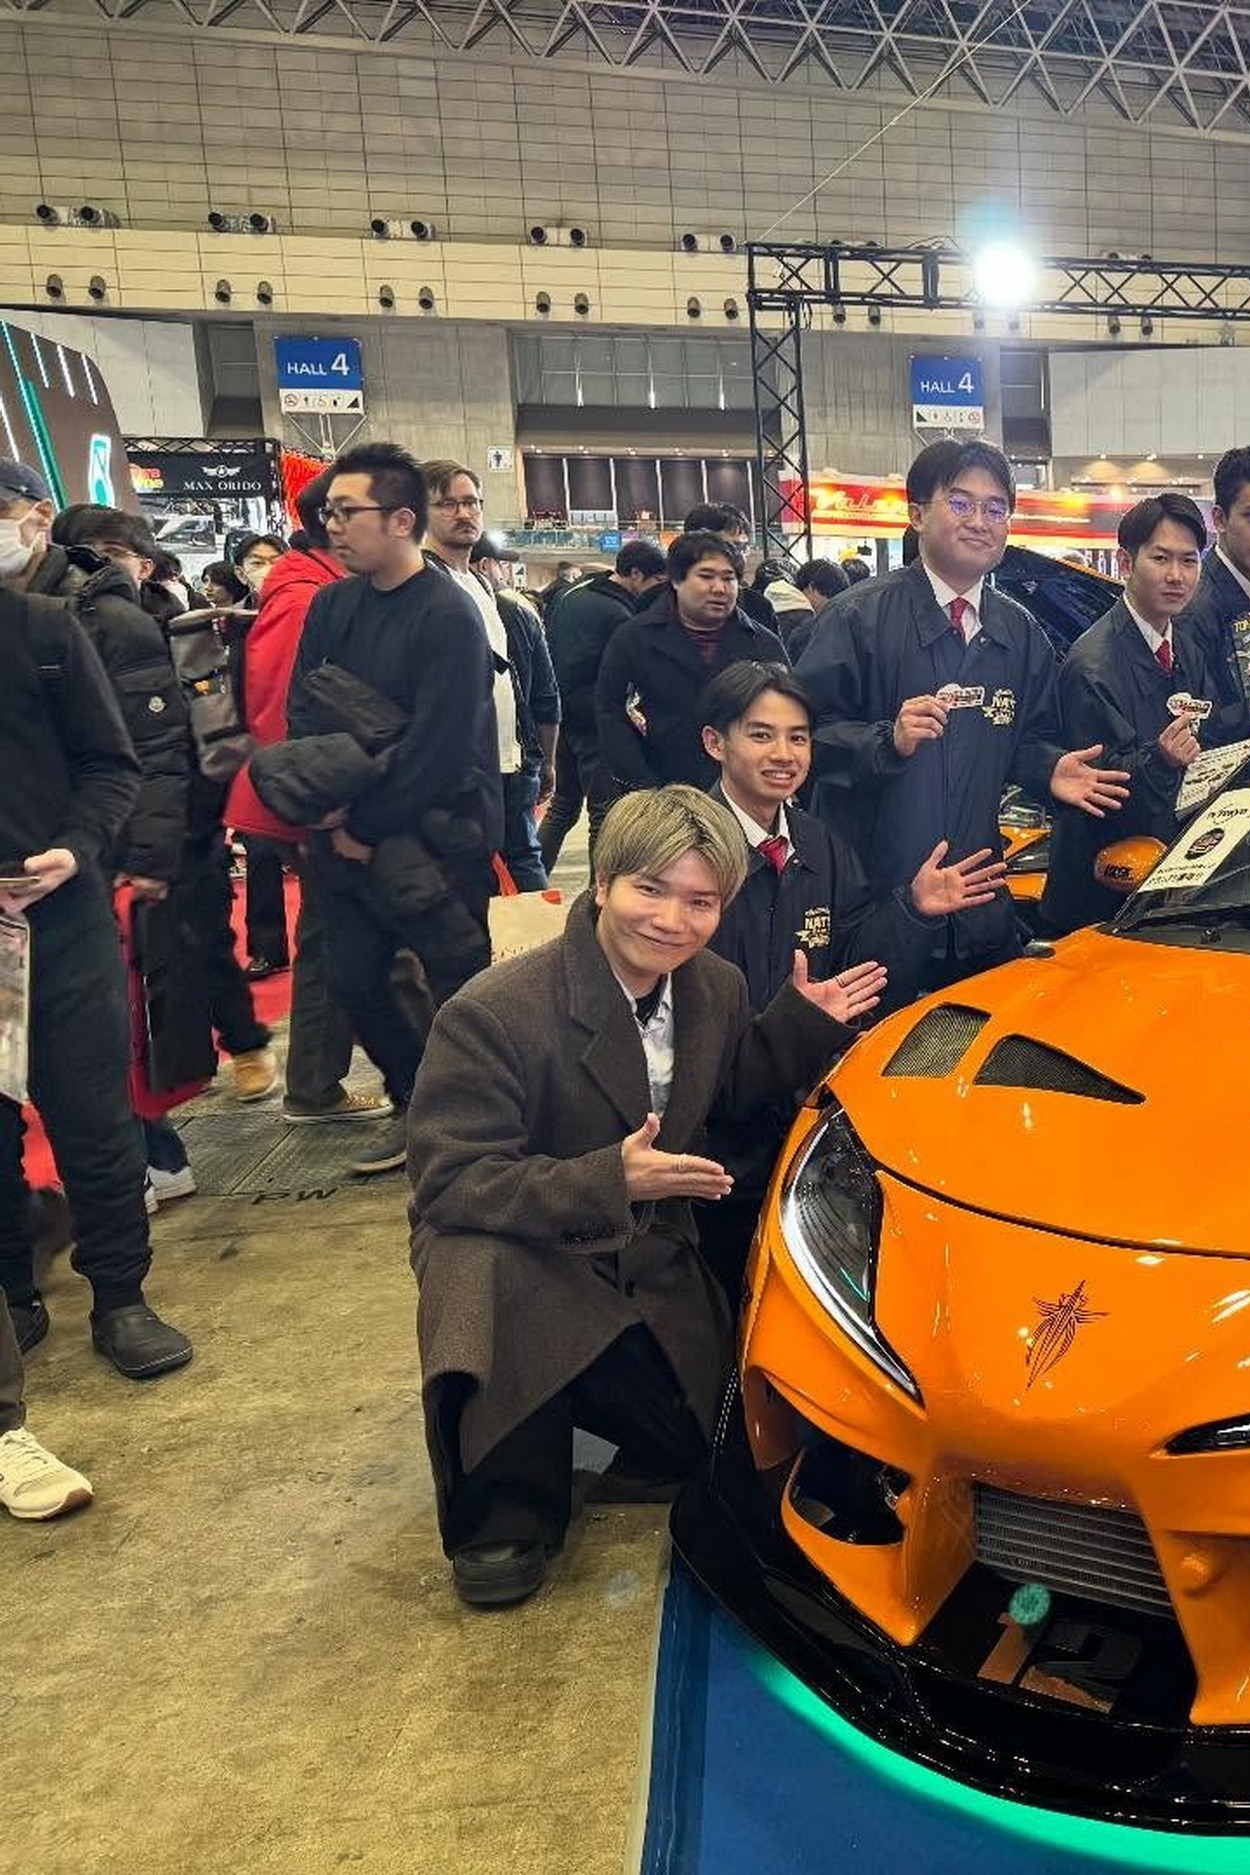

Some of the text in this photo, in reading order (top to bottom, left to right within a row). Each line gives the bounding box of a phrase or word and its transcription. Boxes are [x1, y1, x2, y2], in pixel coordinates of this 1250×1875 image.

[286, 353, 350, 376] HALL 4
[920, 372, 975, 394] HALL 4
[183, 481, 262, 491] MAX ORIDO
